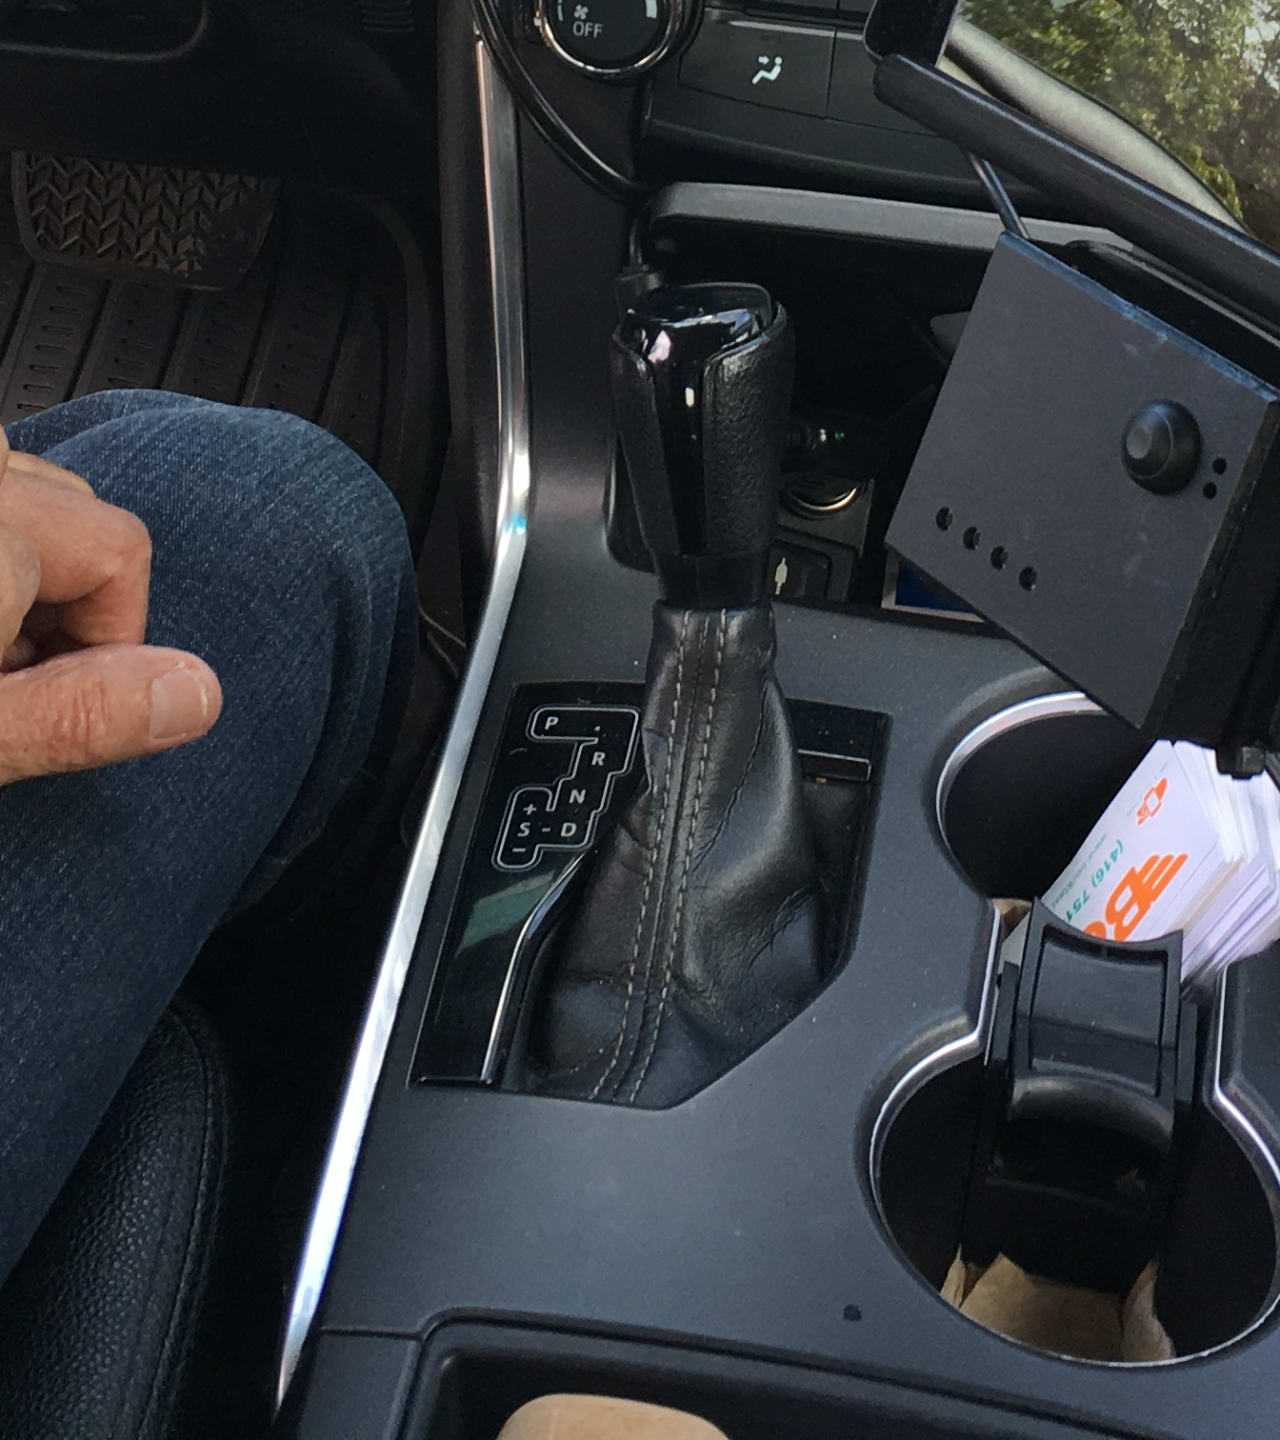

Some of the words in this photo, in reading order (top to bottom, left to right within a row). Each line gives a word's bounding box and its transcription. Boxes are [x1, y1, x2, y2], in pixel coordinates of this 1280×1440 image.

[572, 20, 603, 39] OFF
[543, 716, 559, 730] P
[591, 751, 605, 766] R
[569, 789, 586, 805] N
[517, 822, 531, 838] S
[560, 822, 577, 838] D
[1091, 839, 1124, 888] (416)
